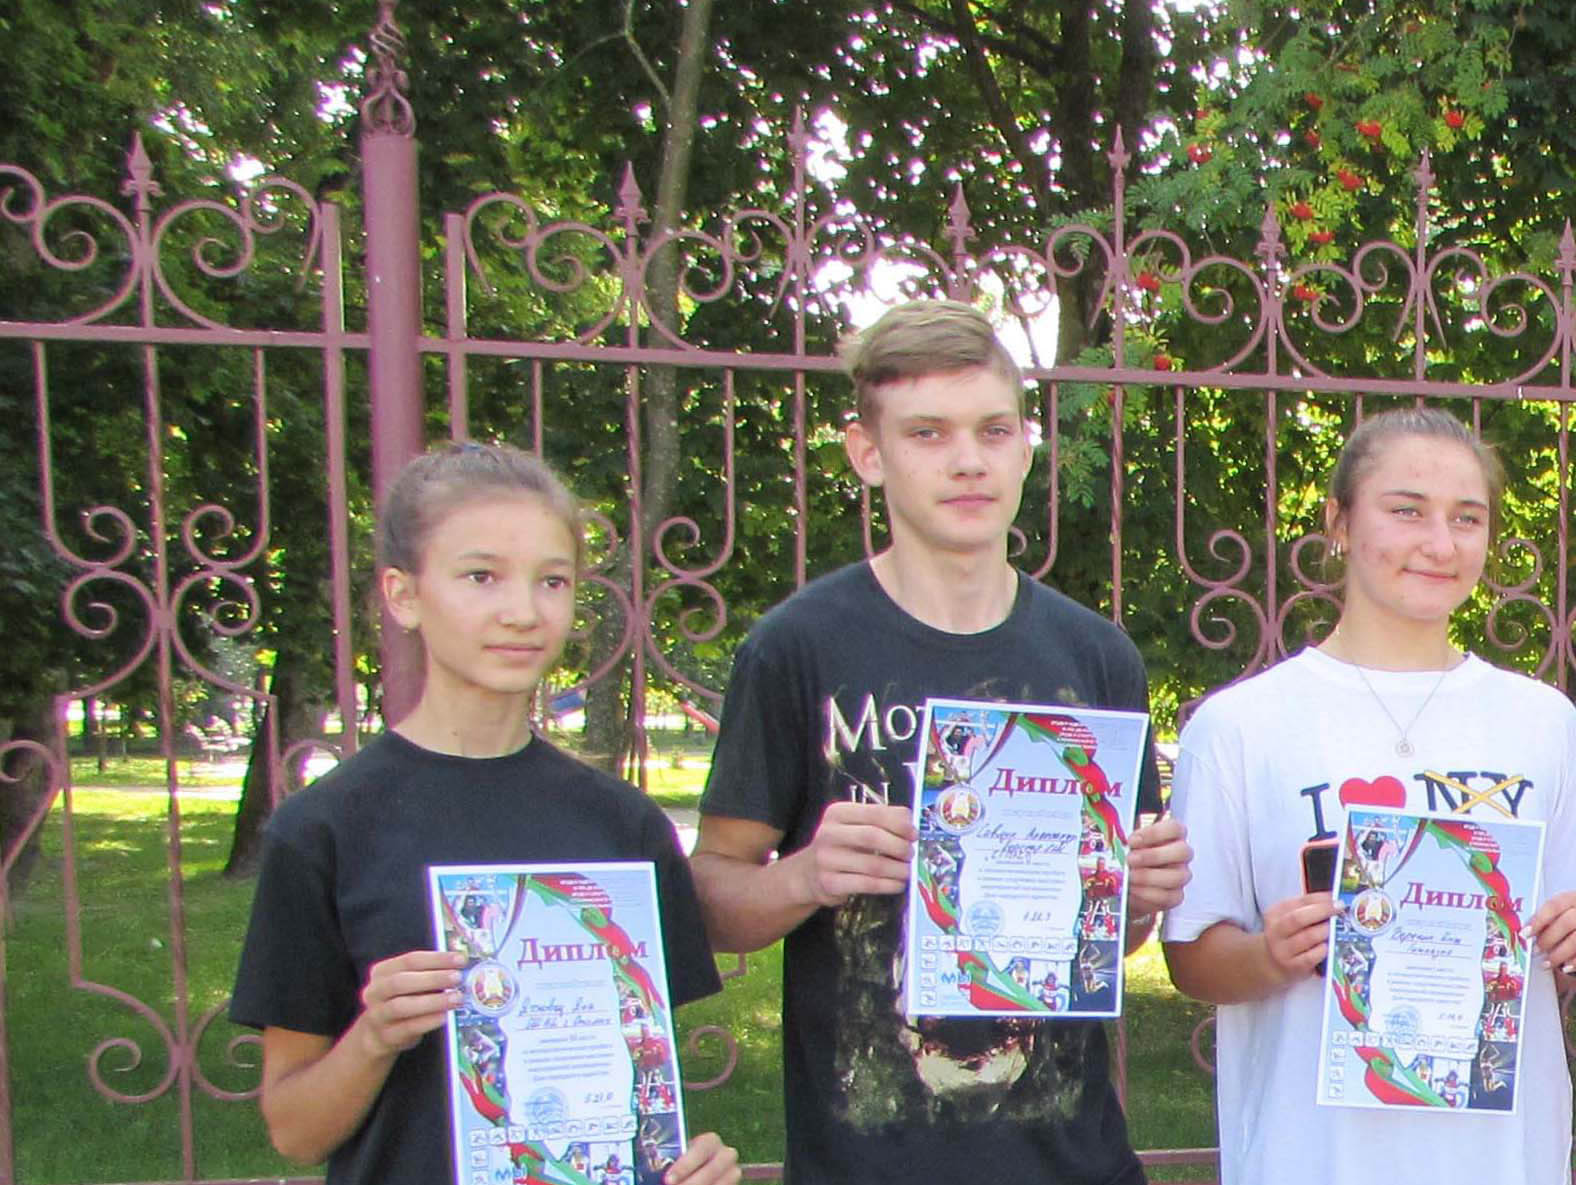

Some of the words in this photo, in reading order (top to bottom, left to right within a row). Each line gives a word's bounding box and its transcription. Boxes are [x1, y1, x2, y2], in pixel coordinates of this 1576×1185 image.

[989, 768, 1122, 797] Диплом
[1401, 882, 1523, 913] Диплом
[517, 938, 648, 969] Диплом
